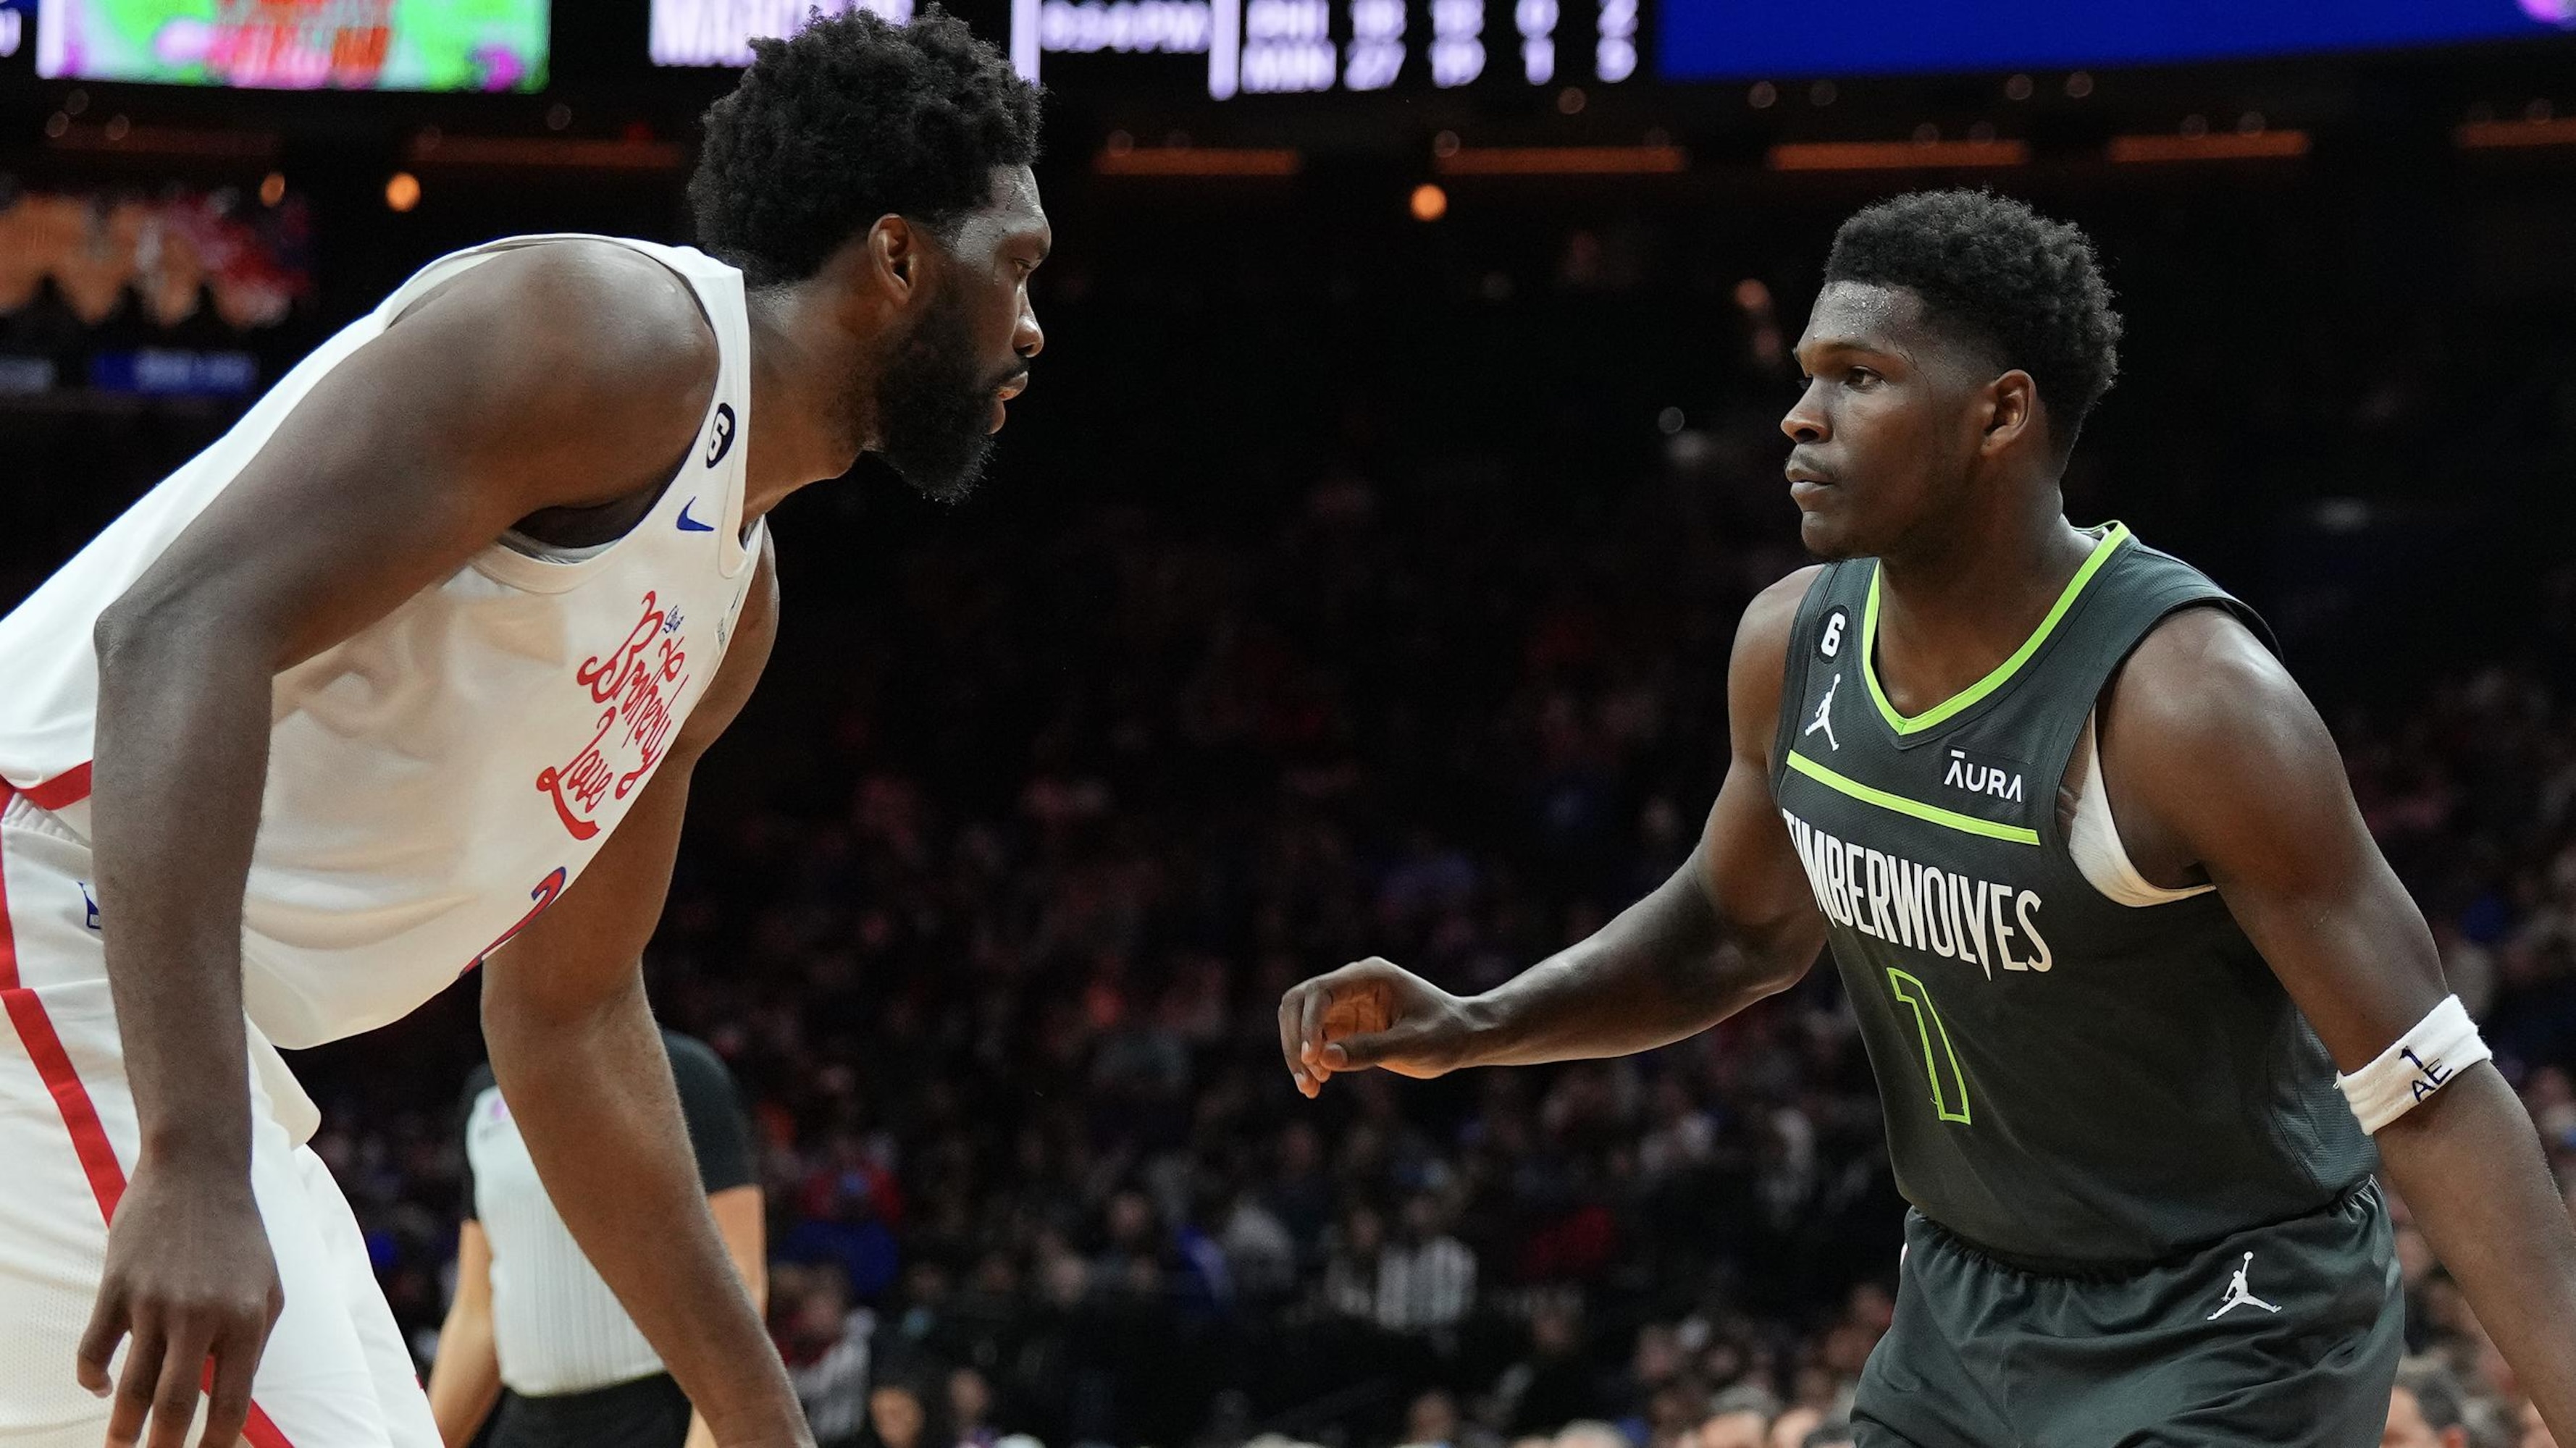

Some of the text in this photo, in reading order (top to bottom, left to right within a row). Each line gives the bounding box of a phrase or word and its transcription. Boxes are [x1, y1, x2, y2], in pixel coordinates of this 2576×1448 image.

[708, 412, 730, 461] 6
[1820, 613, 1845, 657] 6
[536, 707, 613, 841] Love
[1782, 807, 2053, 982] TIMBERWOLVES
[1887, 967, 1971, 1125] 1
[2412, 1058, 2454, 1103] AE
